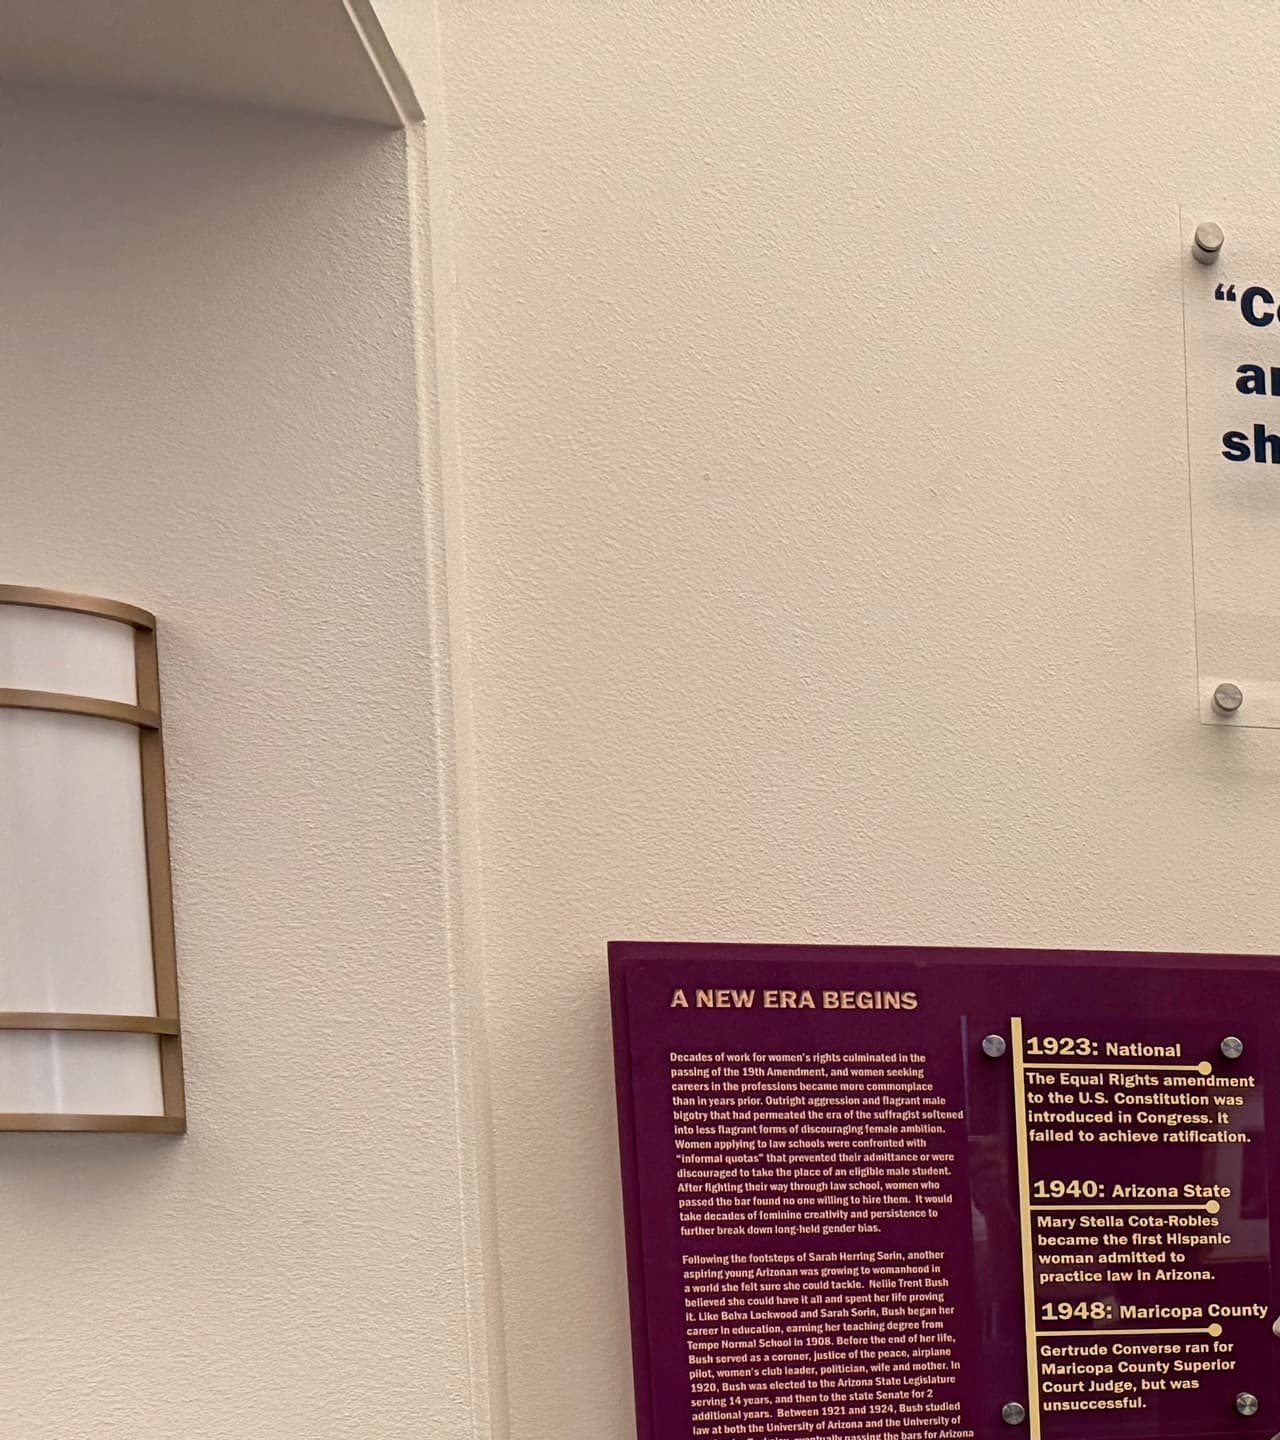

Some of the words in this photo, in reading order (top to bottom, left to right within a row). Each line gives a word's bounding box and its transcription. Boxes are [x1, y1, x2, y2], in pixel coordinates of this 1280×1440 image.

[670, 989, 688, 1007] A
[696, 989, 755, 1008] NEW
[763, 990, 815, 1008] ERA
[822, 990, 917, 1010] BEGINS
[1027, 1036, 1098, 1056] 1923:
[1106, 1042, 1181, 1057] National
[670, 1052, 713, 1062] Decades
[714, 1052, 725, 1062] of
[726, 1052, 750, 1062] work
[752, 1052, 766, 1062] for
[767, 1052, 811, 1062] women's
[812, 1052, 841, 1064] rights
[842, 1052, 897, 1062] culminated
[898, 1053, 908, 1062] in
[910, 1053, 926, 1062] the
[1033, 1180, 1104, 1198] 1940:
[1111, 1184, 1178, 1197] Arizona
[1183, 1184, 1231, 1197] State
